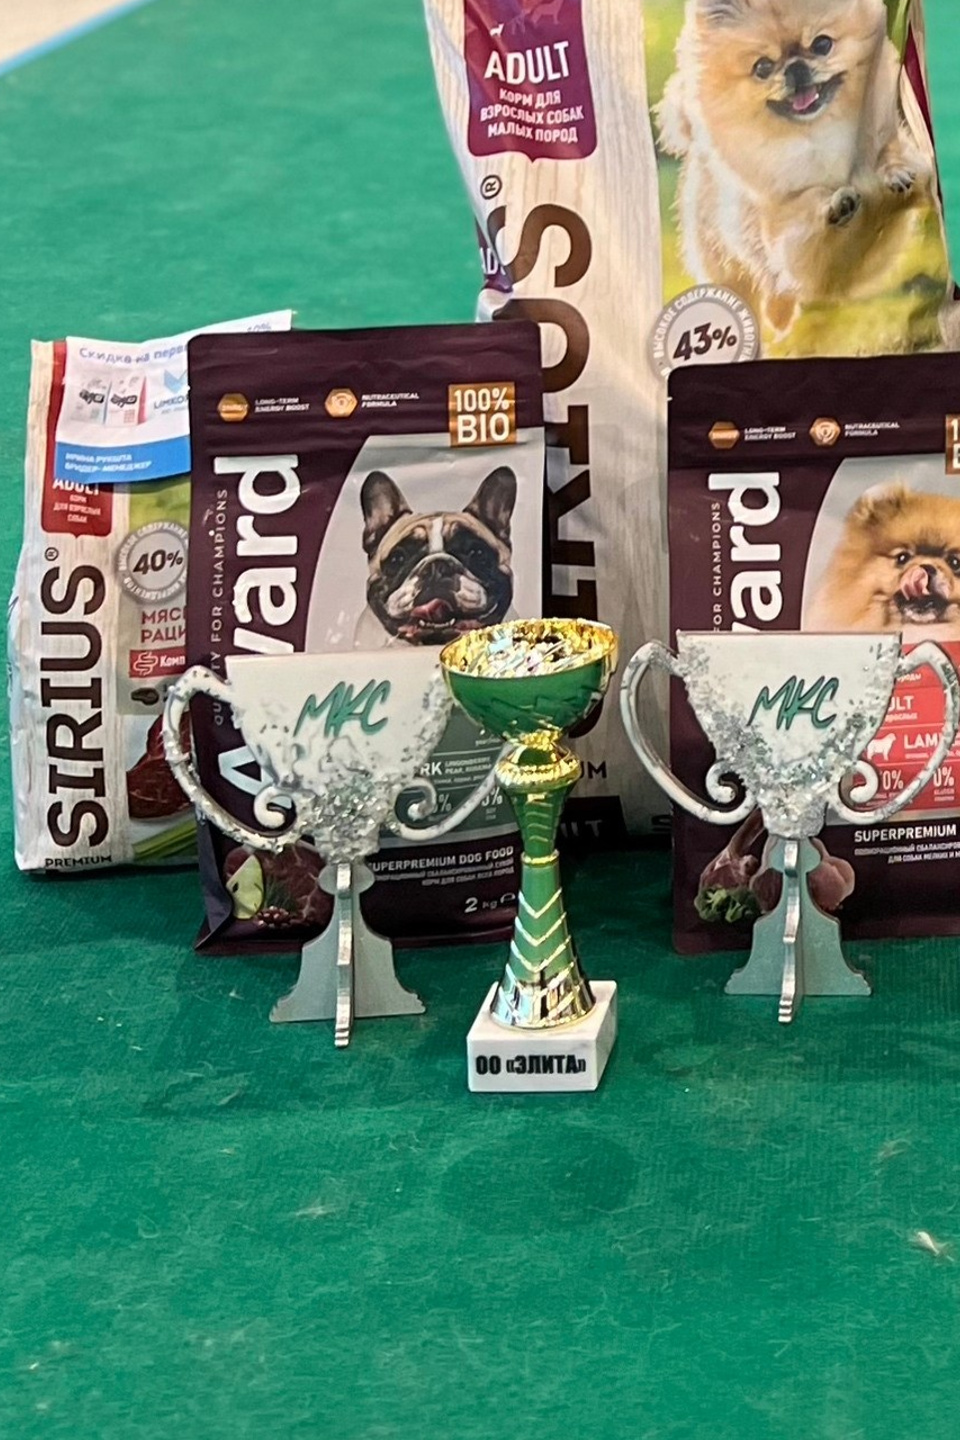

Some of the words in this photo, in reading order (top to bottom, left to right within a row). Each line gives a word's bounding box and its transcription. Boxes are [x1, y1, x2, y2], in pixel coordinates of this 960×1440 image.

[483, 40, 570, 85] ADULT
[499, 88, 533, 106] КОРМ
[534, 90, 561, 109] ДЛЯ
[480, 103, 545, 124] ВЗРОСЛЫХ
[546, 105, 584, 124] СОБАК
[487, 121, 533, 139] МАЛЫХ
[534, 127, 579, 143] ПОРОД
[672, 322, 738, 361] 43%
[79, 347, 132, 364] Скидка
[454, 387, 510, 412] 100%
[457, 412, 510, 444] BIO
[213, 489, 228, 598] CHAMPIONS
[708, 471, 784, 632] ard
[711, 501, 723, 598] CHAMPIONS
[132, 549, 184, 576] 40%
[141, 607, 187, 625] МЯС
[211, 606, 224, 642] FOR
[214, 454, 301, 809] Aard
[40, 563, 110, 848] SIRIUS
[419, 760, 443, 777] RK
[854, 823, 957, 843] SUPERPREMIUM
[44, 854, 113, 868] PREMIUM
[369, 854, 456, 873] UPERPREMIUM
[459, 851, 483, 865] DOG
[485, 845, 515, 861] FOOD
[464, 896, 479, 913] 2
[506, 1054, 587, 1075] «ЭЛИТА»
